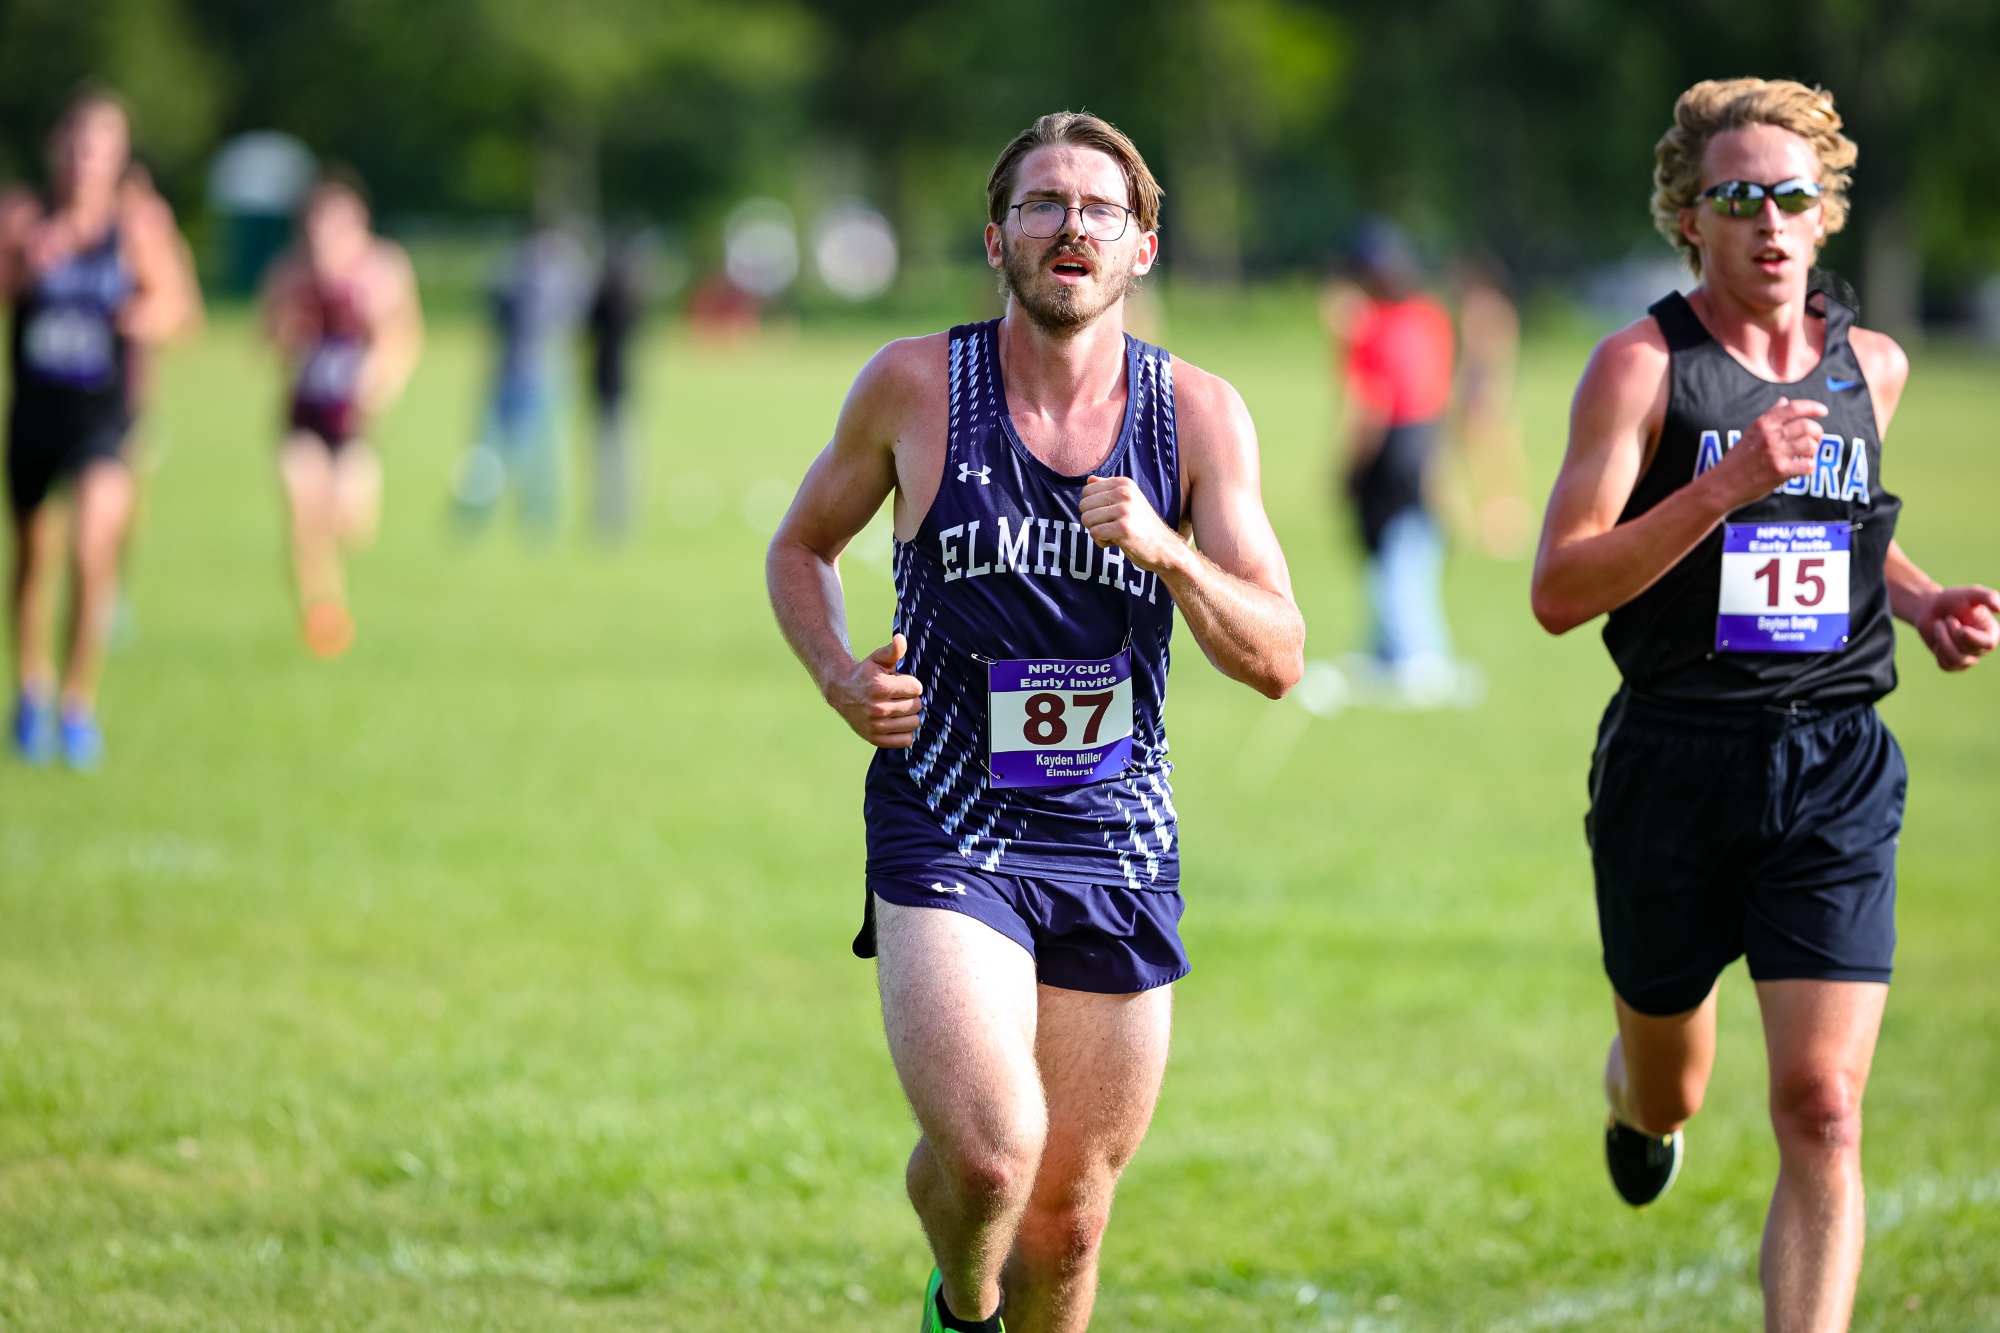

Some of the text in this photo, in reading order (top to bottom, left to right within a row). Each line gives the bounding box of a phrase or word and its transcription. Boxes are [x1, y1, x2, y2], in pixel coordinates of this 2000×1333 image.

[1692, 430, 1870, 505] ARA
[1756, 526, 1826, 540] NPU/CUC
[1748, 539, 1832, 553] Early Invite
[1754, 558, 1825, 606] 15
[1772, 631, 1805, 642] Aurora
[1028, 664, 1111, 676] NPU/CUC
[1020, 676, 1117, 689] Early Invite
[1023, 690, 1114, 745] 87
[1036, 752, 1103, 768] Kayden Miller
[1046, 767, 1094, 777] Elmhurst
